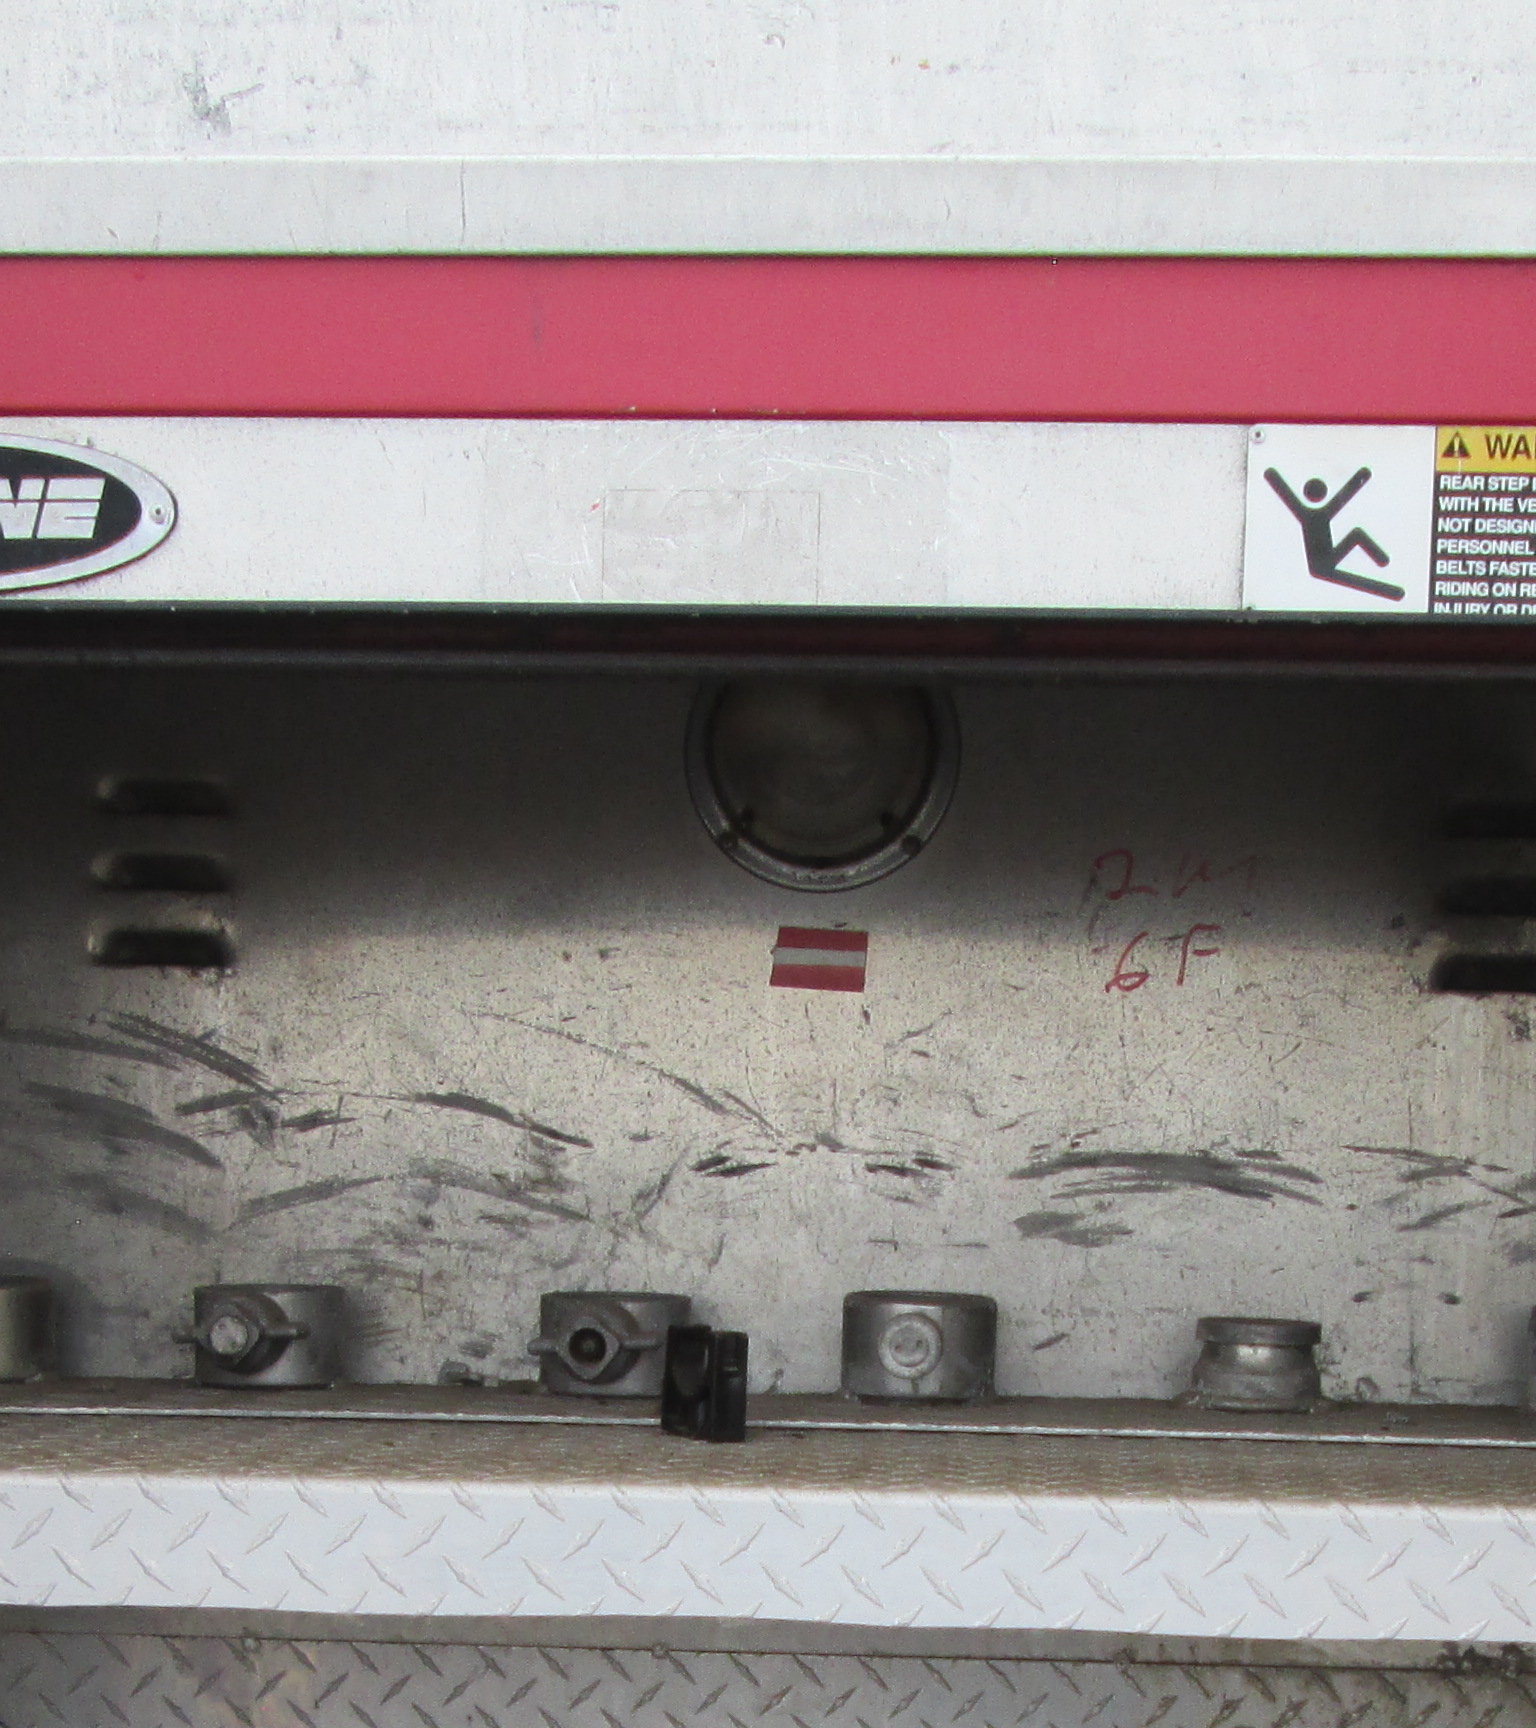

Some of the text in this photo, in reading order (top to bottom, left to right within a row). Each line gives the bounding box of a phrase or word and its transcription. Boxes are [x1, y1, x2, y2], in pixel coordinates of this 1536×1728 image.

[1440, 475, 1485, 491] REAR
[1488, 476, 1529, 491] STEP
[1438, 496, 1479, 512] WITH
[1483, 497, 1514, 512] THE
[1437, 518, 1471, 532] NOT
[1437, 538, 1534, 555] PERSONNEL
[1436, 560, 1486, 575] BELTS
[1435, 581, 1488, 596] RIDING
[1492, 582, 1515, 597] ON
